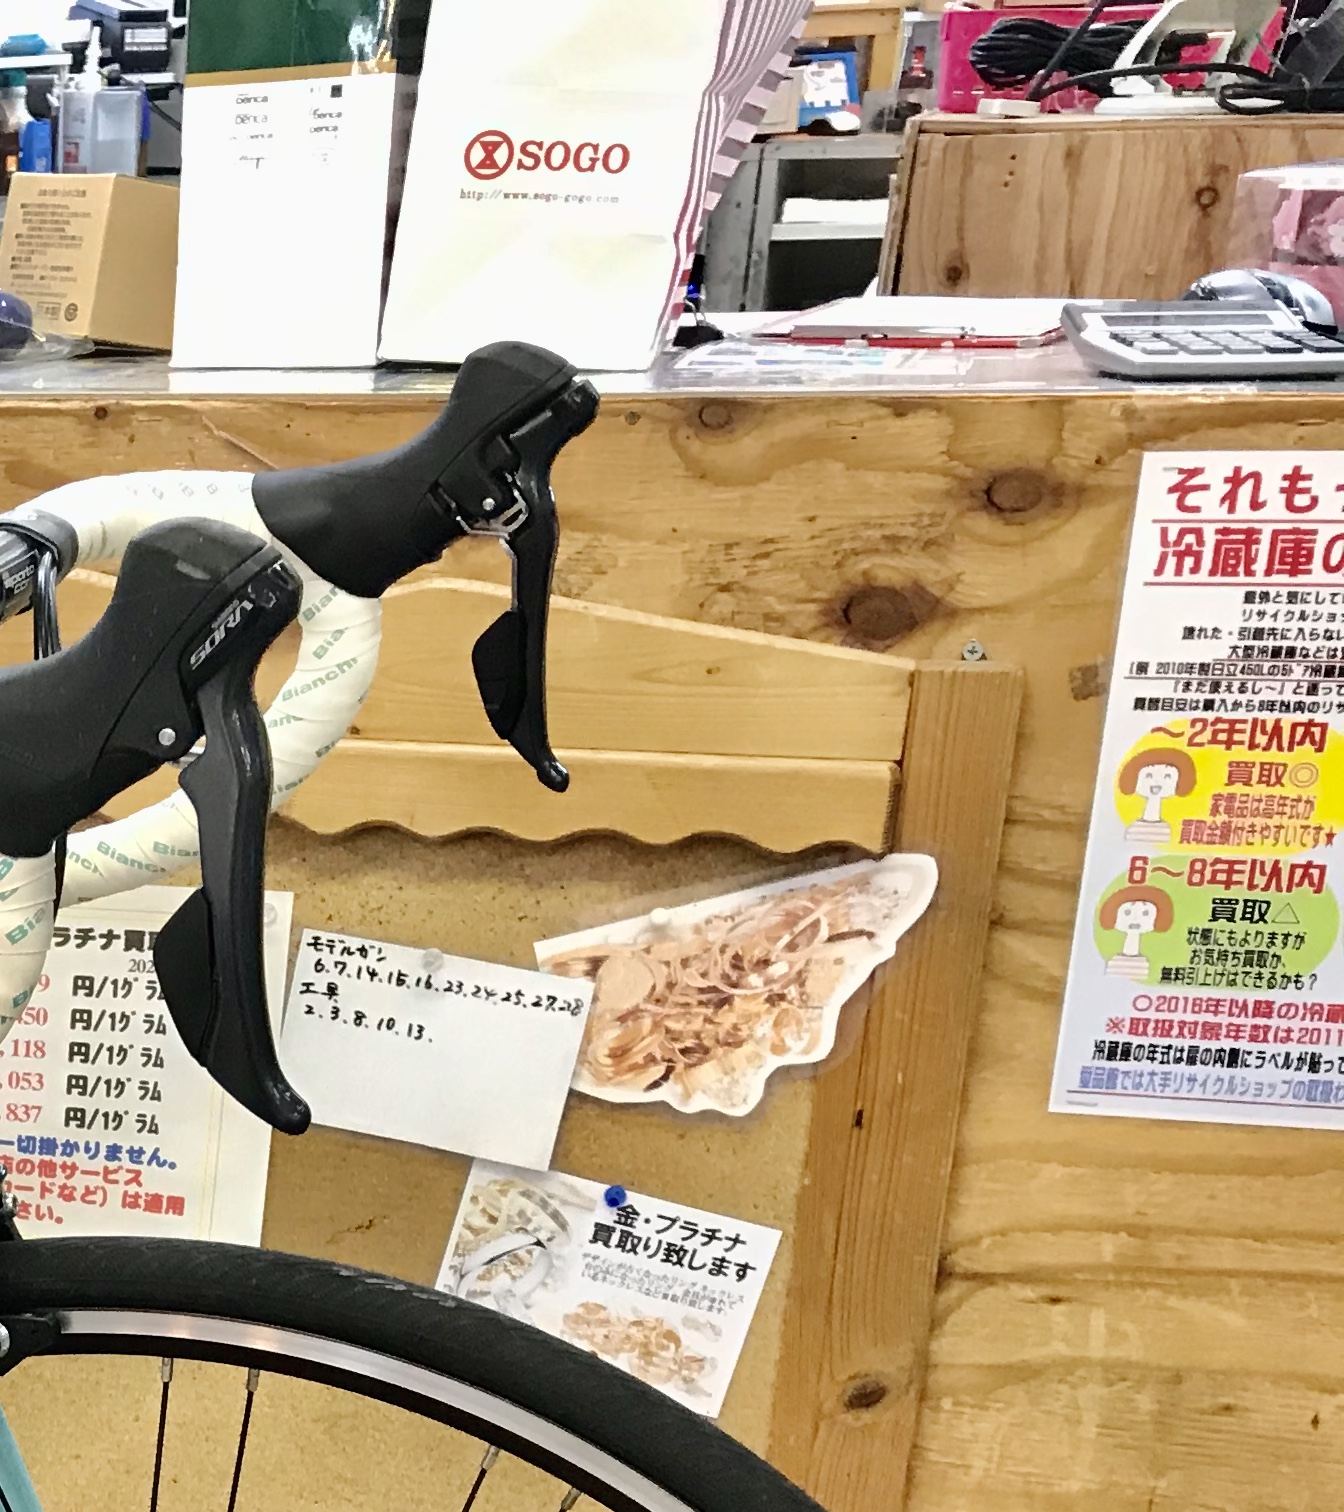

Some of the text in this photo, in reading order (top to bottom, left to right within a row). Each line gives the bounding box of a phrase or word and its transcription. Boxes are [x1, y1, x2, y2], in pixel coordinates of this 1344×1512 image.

[516, 140, 631, 175] SOGO
[1166, 464, 1344, 515] それも
[1242, 608, 1344, 623] リサイクルショ
[306, 935, 387, 962] モデルガン
[612, 1203, 748, 1253] 金・プラチナ
[588, 1221, 757, 1283] 買取り致します
